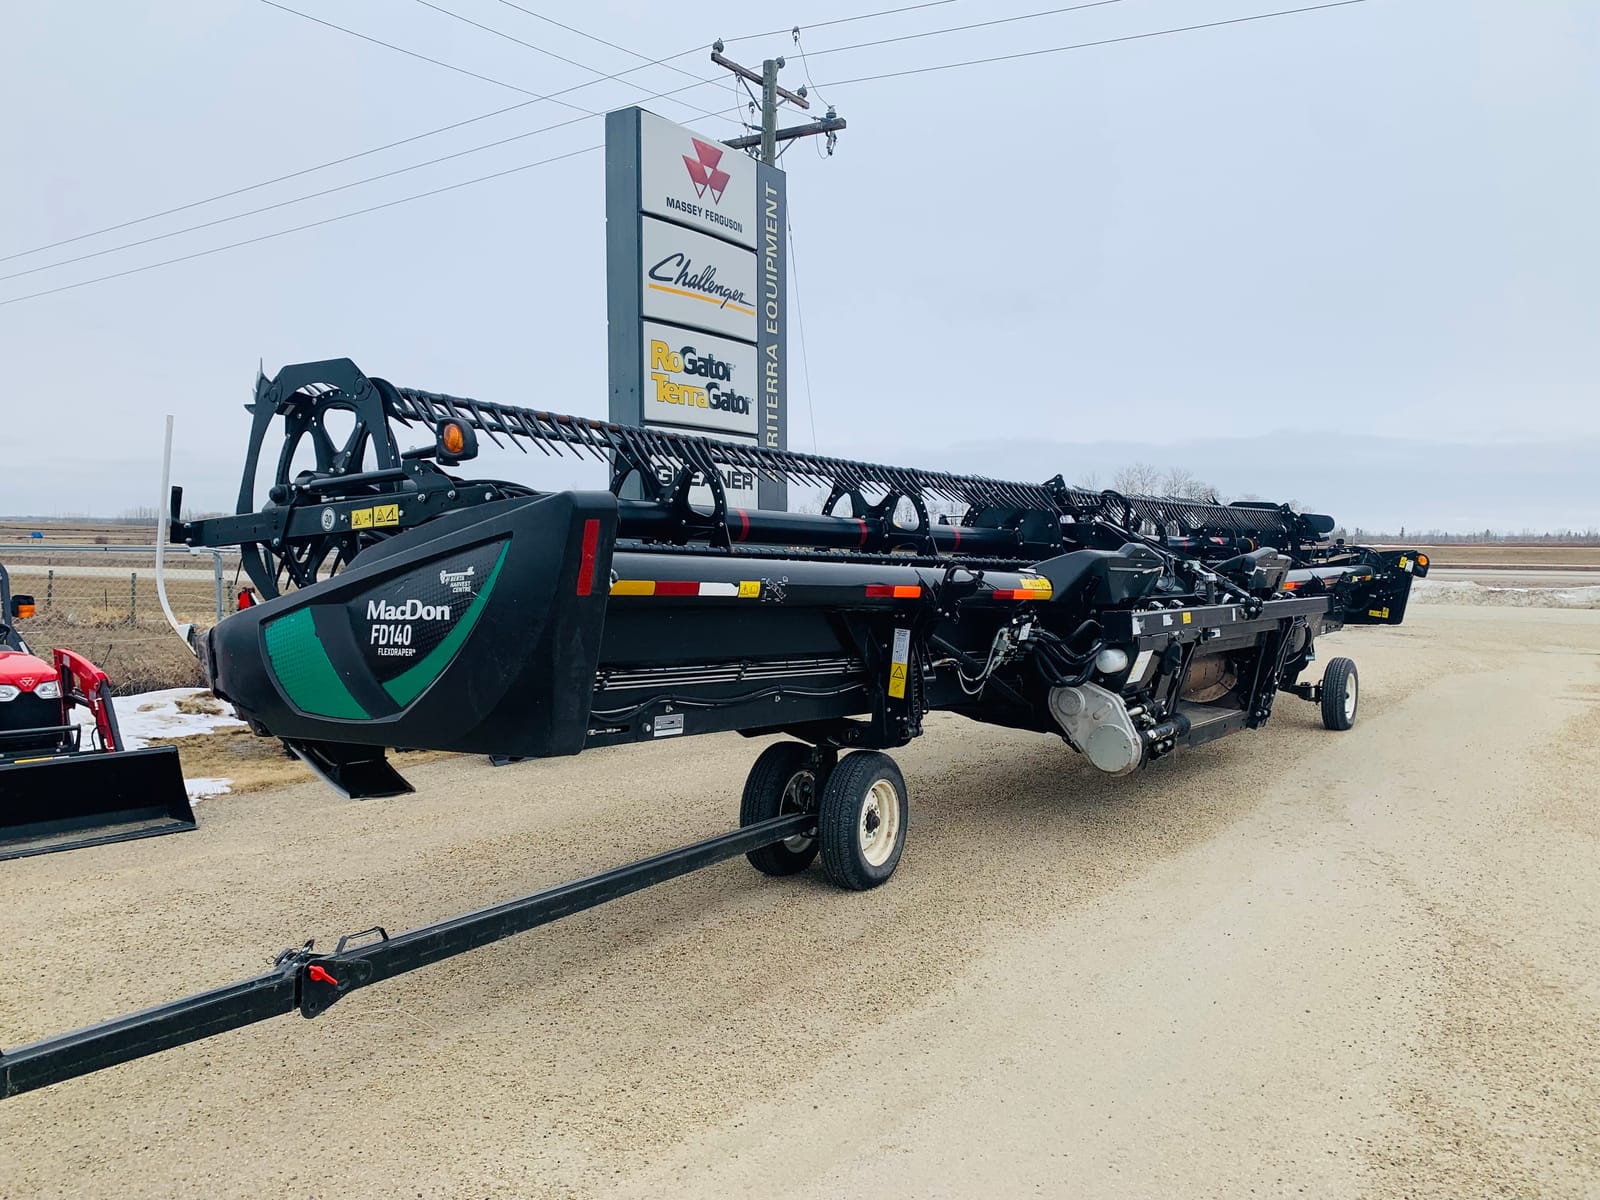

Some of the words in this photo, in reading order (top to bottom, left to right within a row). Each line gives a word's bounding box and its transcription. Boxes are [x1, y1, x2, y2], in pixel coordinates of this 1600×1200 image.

[666, 197, 703, 217] MASSEY
[705, 209, 743, 233] FERGUSON
[765, 181, 778, 335] EQUIPMENT
[648, 253, 755, 309] Challenger
[651, 339, 732, 382] RoGator
[651, 372, 750, 415] TerraGator
[366, 599, 450, 620] MacDon
[370, 624, 412, 645] FD140
